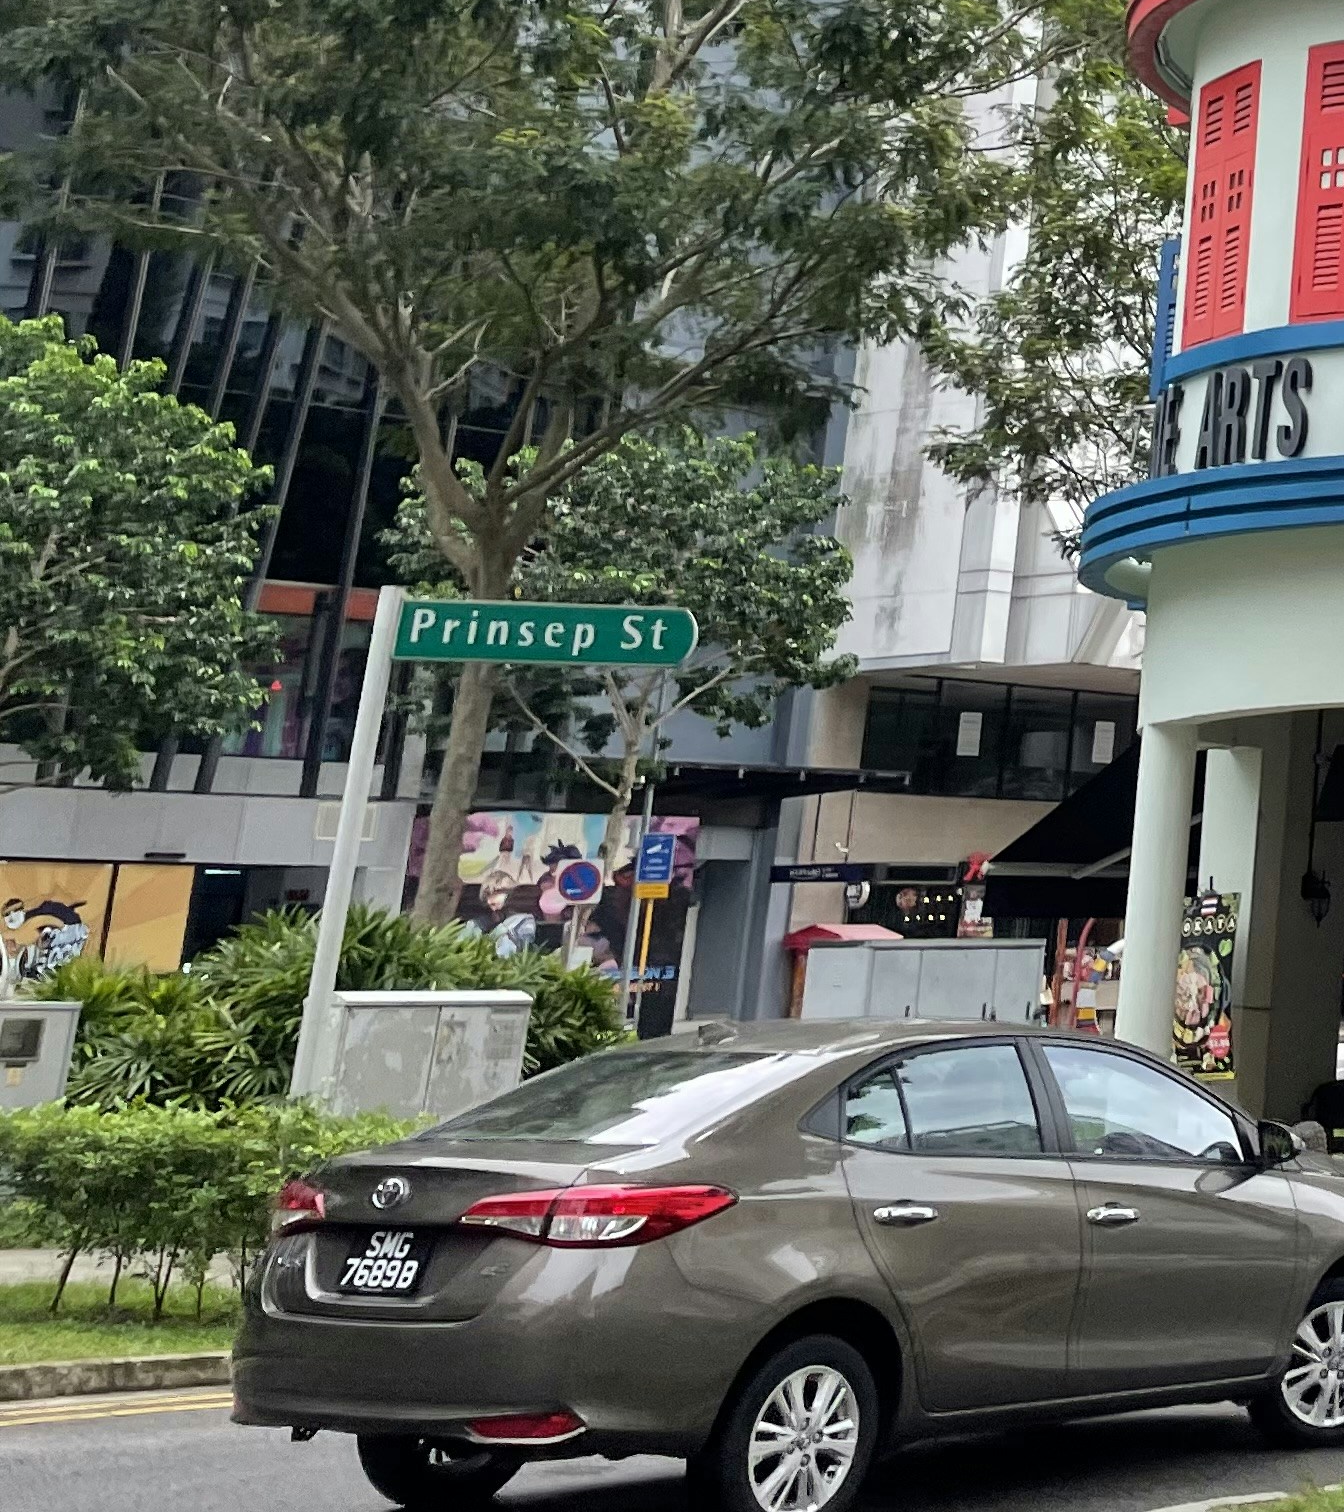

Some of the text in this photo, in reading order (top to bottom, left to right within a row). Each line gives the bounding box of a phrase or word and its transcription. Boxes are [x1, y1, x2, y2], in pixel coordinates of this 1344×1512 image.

[1194, 357, 1313, 470] ARTS
[408, 607, 669, 656] Prinsep St
[365, 1231, 415, 1259] SMG
[340, 1257, 419, 1289] 7689B
